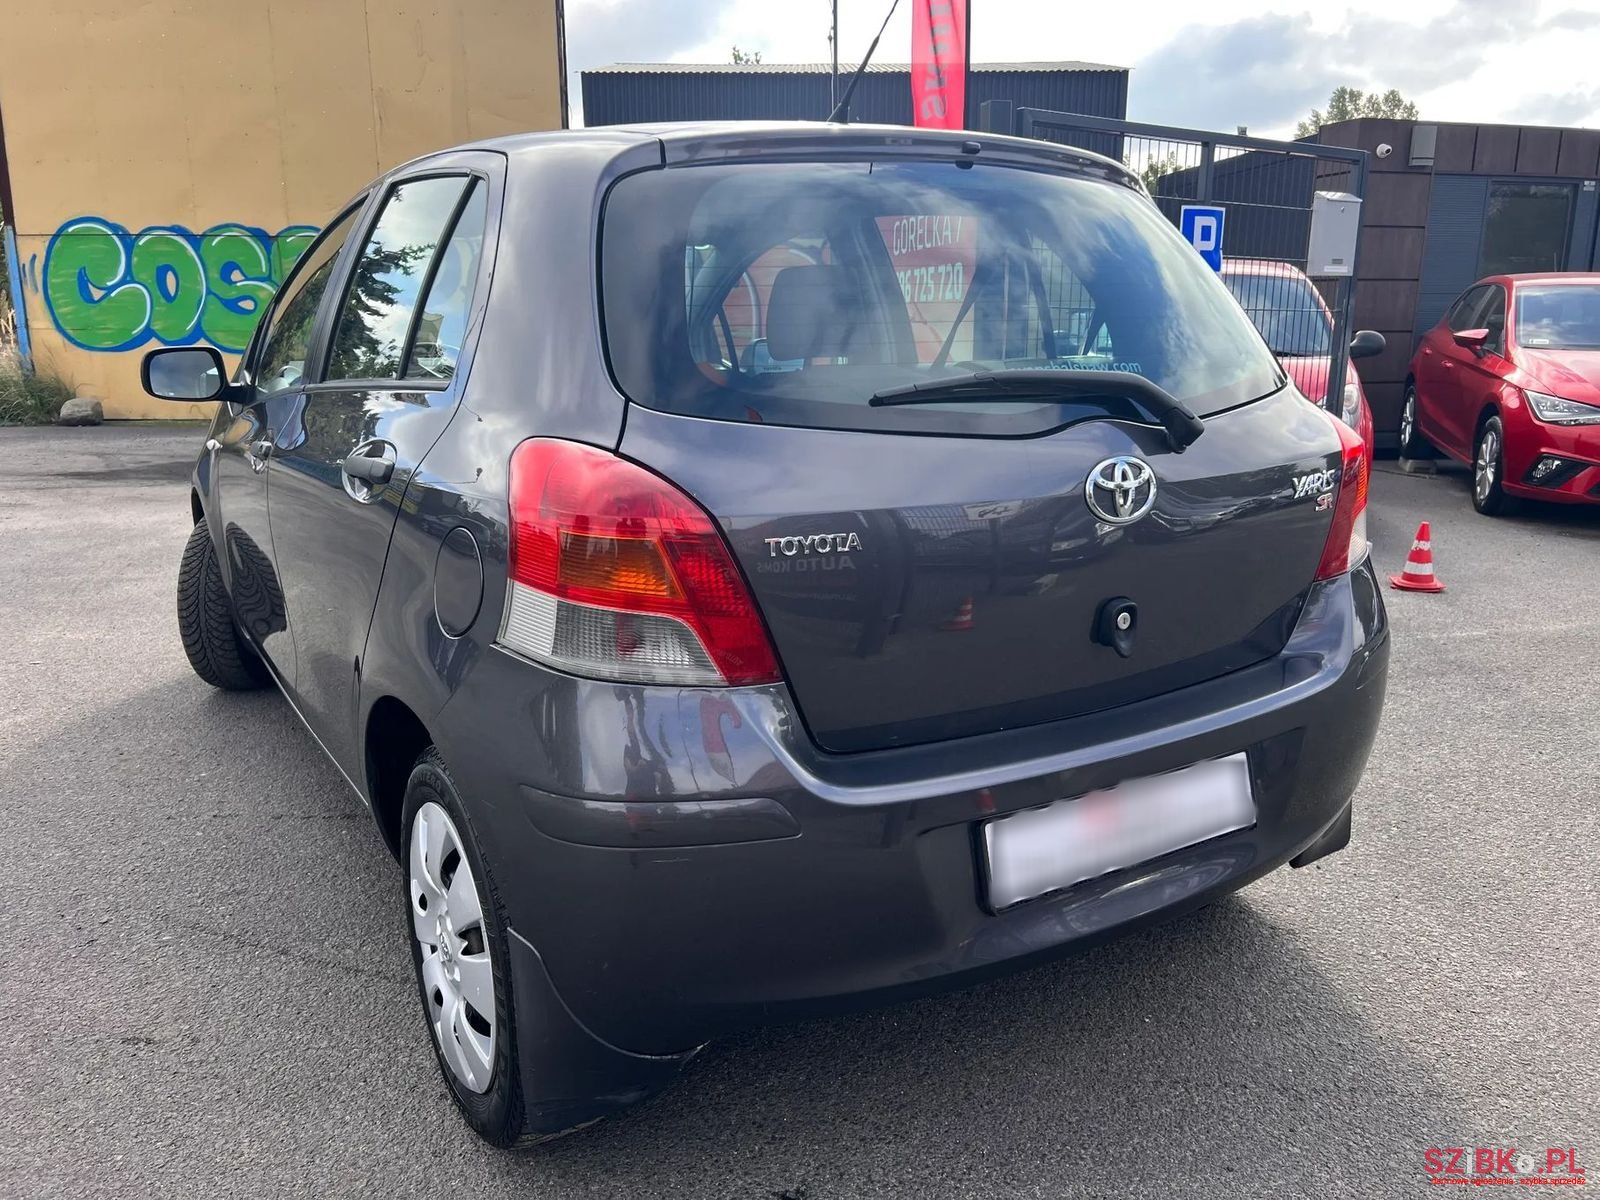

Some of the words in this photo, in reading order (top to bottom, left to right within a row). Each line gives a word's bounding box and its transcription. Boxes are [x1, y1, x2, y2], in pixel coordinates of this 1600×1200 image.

[1193, 215, 1217, 251] P
[42, 215, 322, 353] COS
[914, 266, 935, 302] 725
[938, 262, 963, 301] 720
[1315, 492, 1333, 511] SR
[764, 532, 862, 557] TOYOTA
